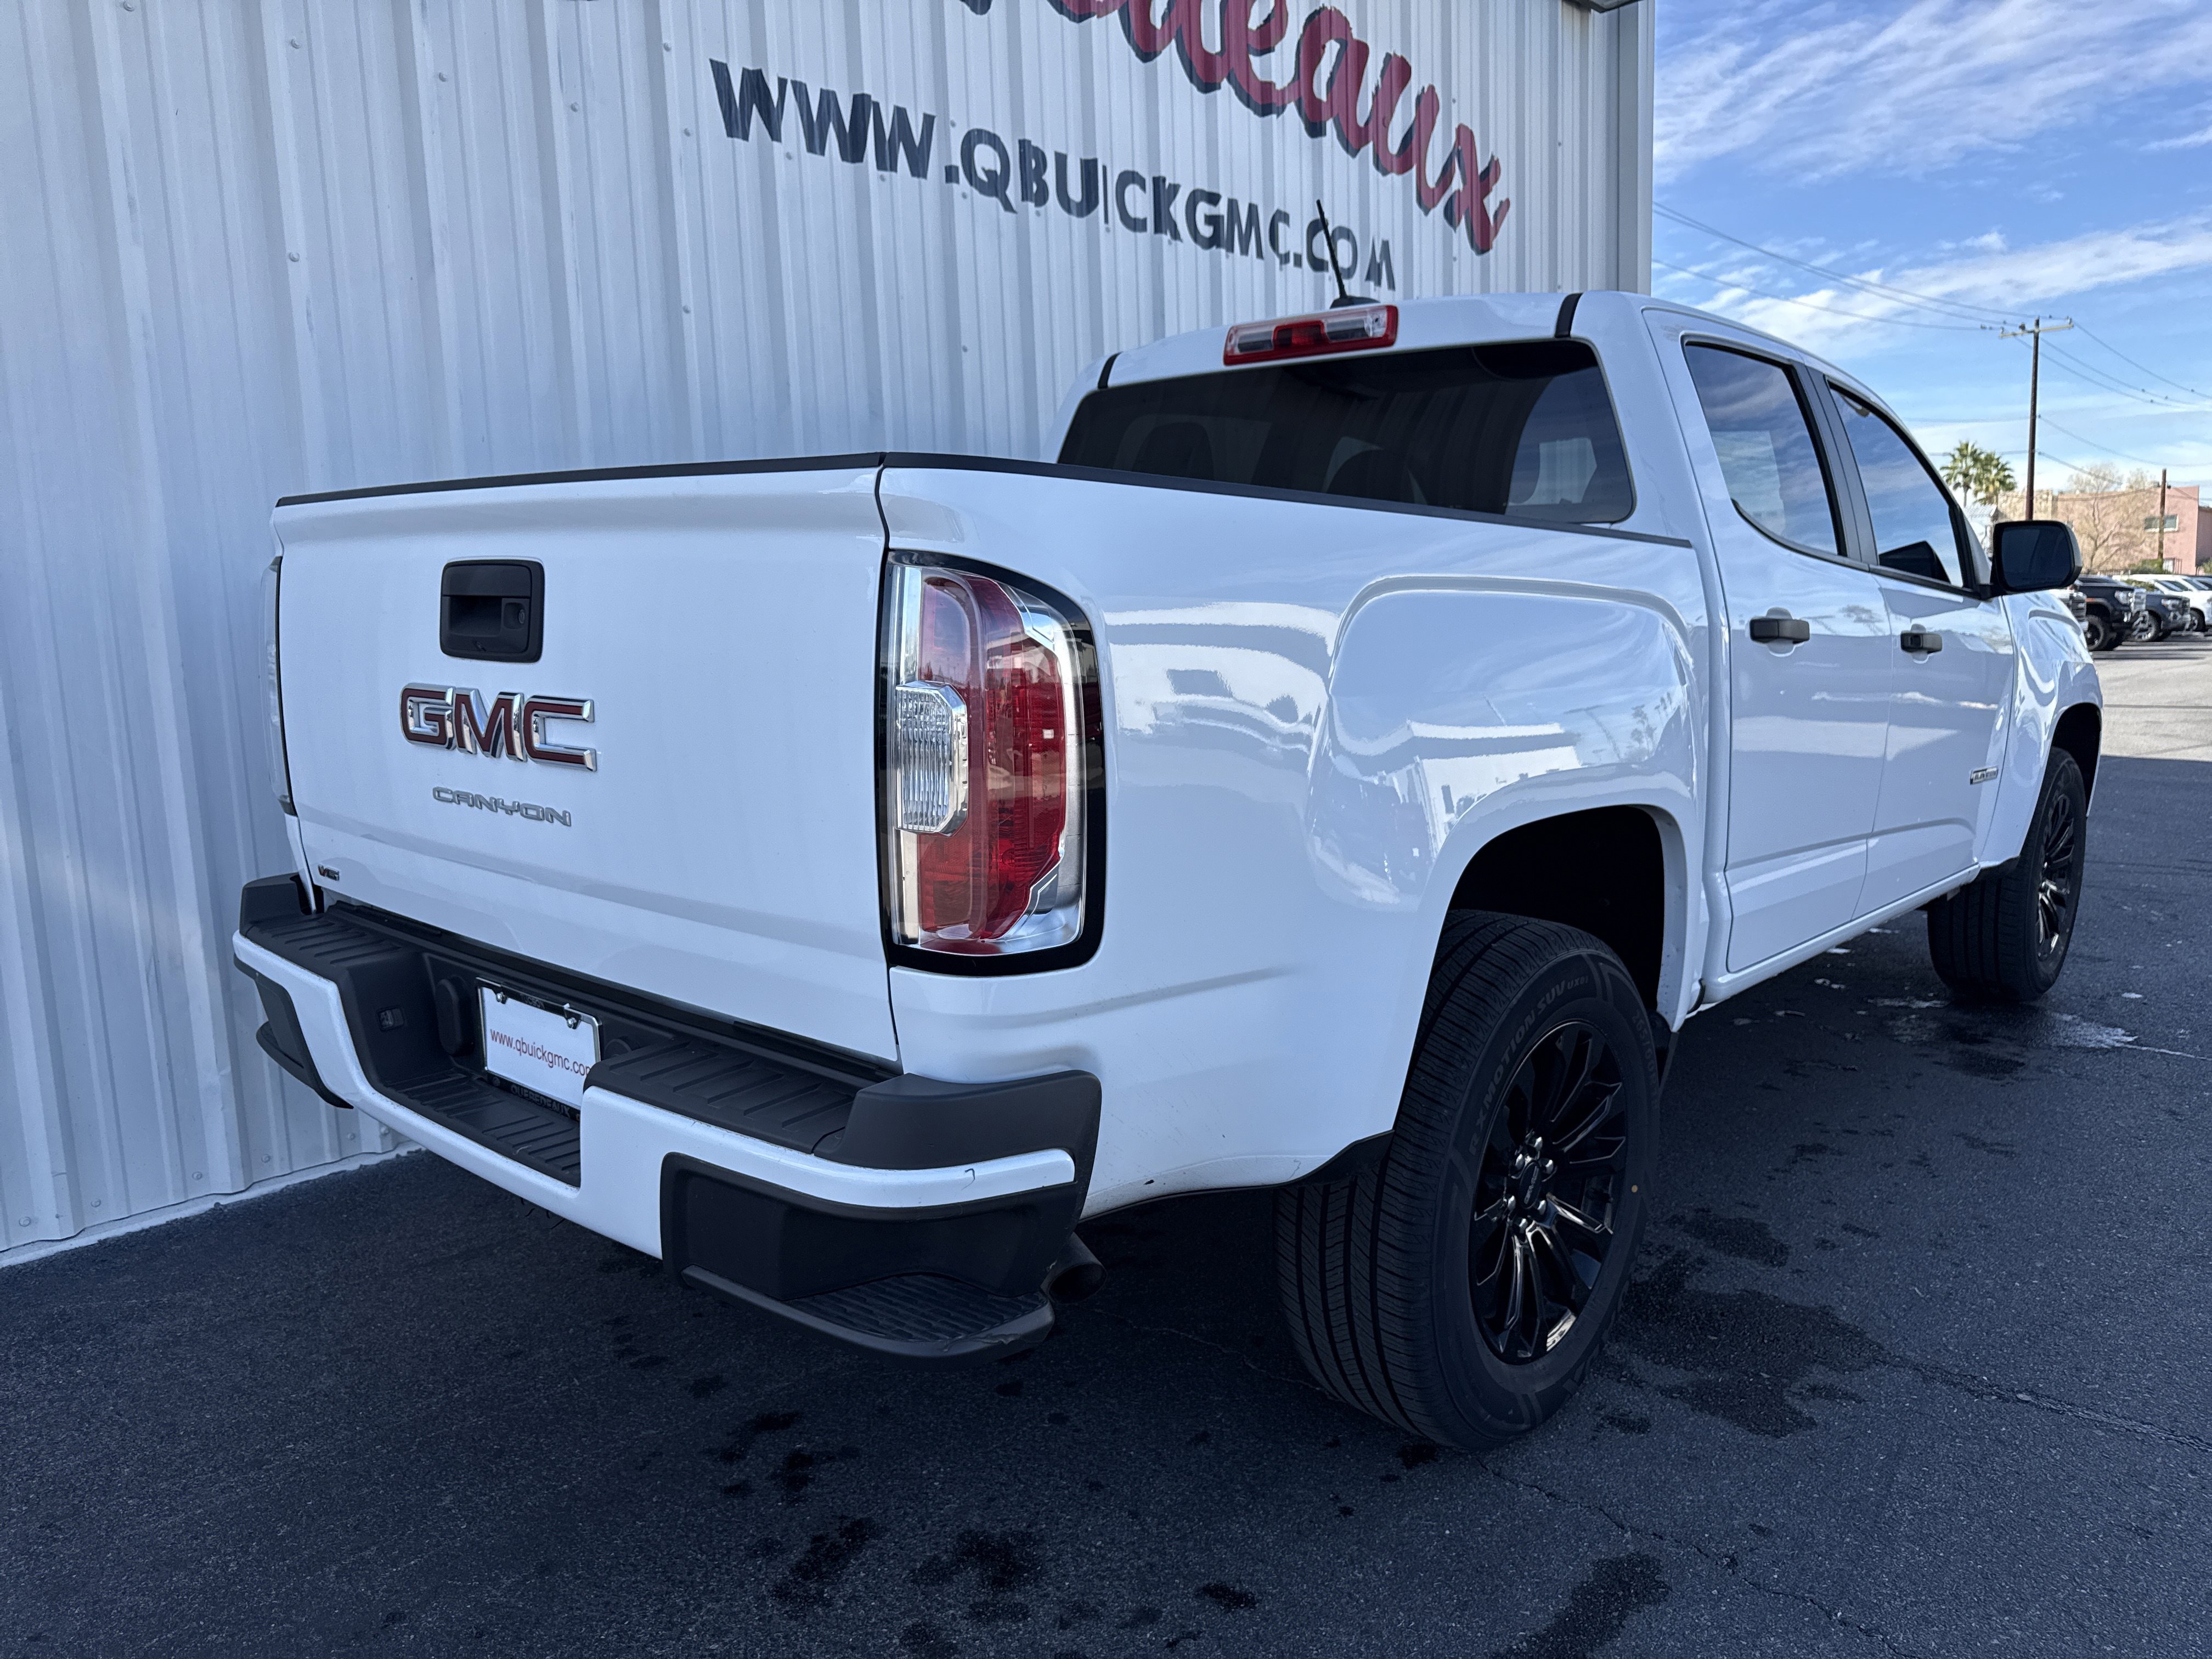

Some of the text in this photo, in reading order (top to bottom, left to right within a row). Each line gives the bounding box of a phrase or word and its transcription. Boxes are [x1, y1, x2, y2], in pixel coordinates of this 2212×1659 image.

[709, 58, 1396, 291] WWW.QBUICKGMC.COM
[400, 682, 597, 772] GMC
[432, 786, 572, 827] CANYON
[1537, 979, 1567, 1015] SUV
